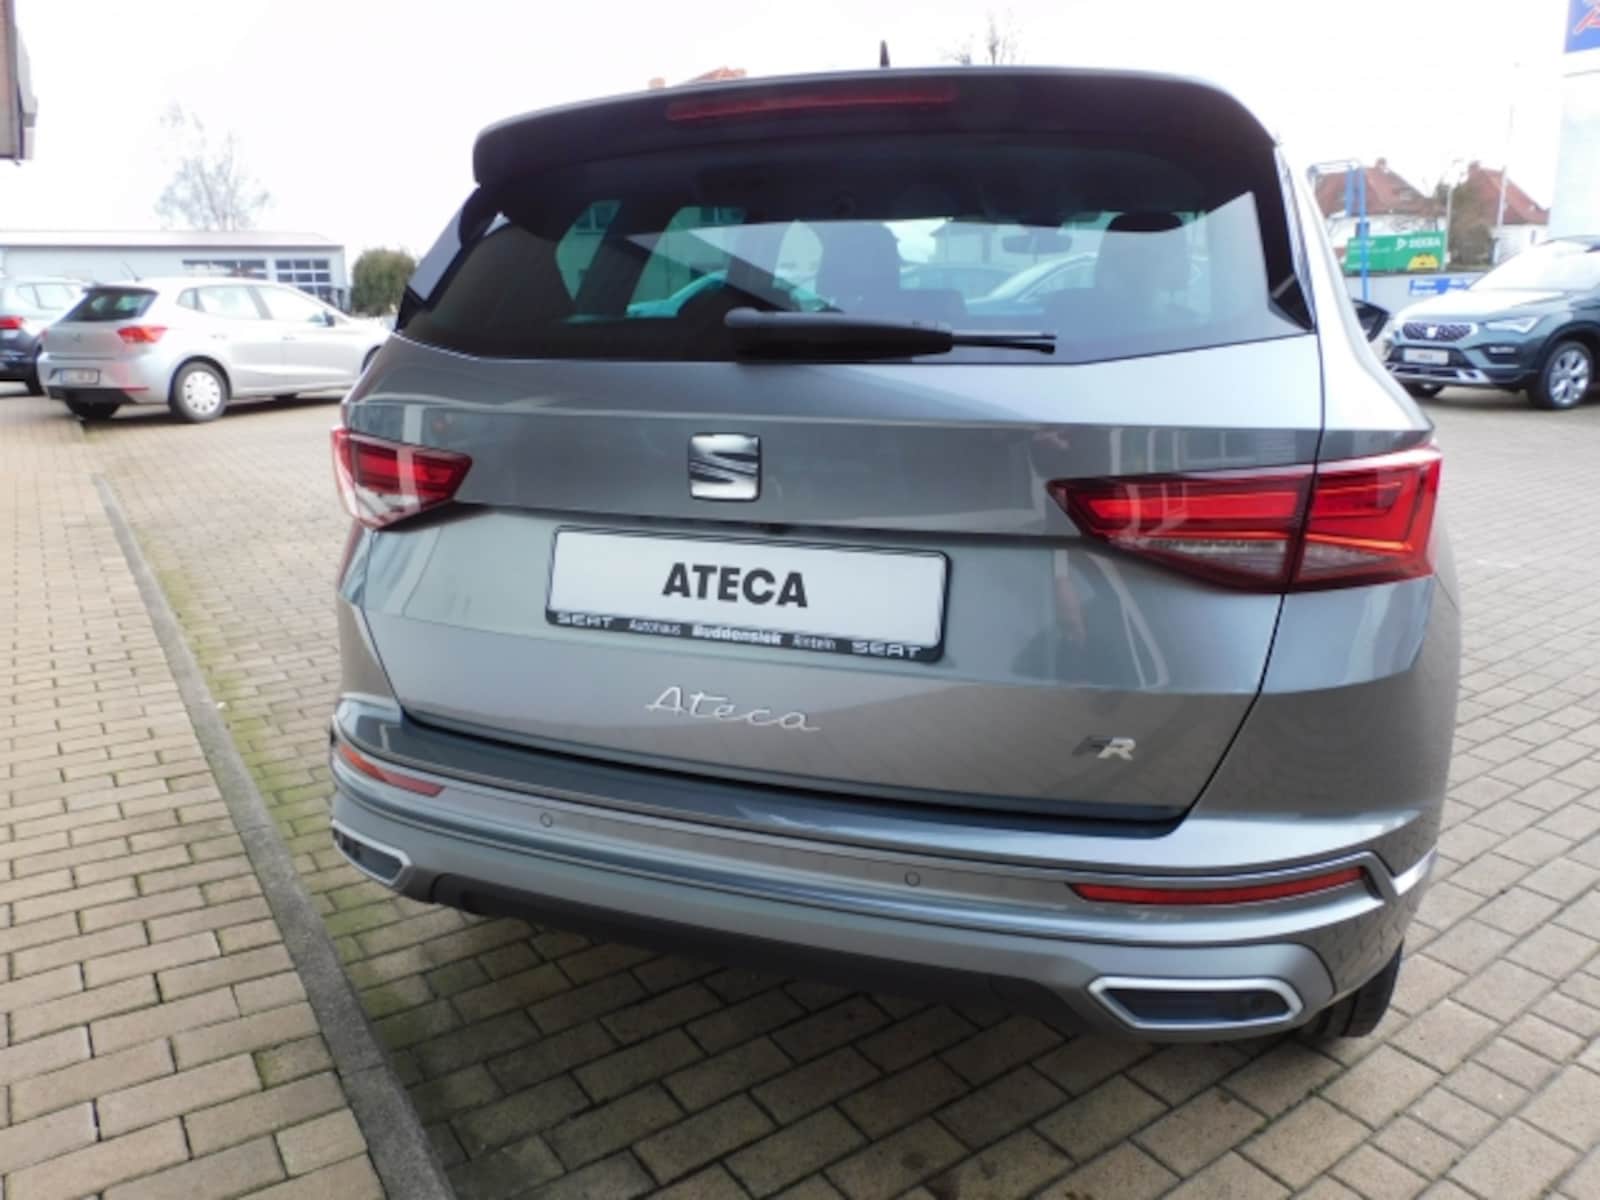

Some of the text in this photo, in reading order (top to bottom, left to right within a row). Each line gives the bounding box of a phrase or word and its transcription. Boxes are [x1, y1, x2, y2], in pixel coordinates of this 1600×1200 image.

[662, 562, 808, 609] ATECA
[556, 612, 614, 629] SEAT
[852, 642, 922, 659] SEAT
[645, 685, 822, 732] Ateca
